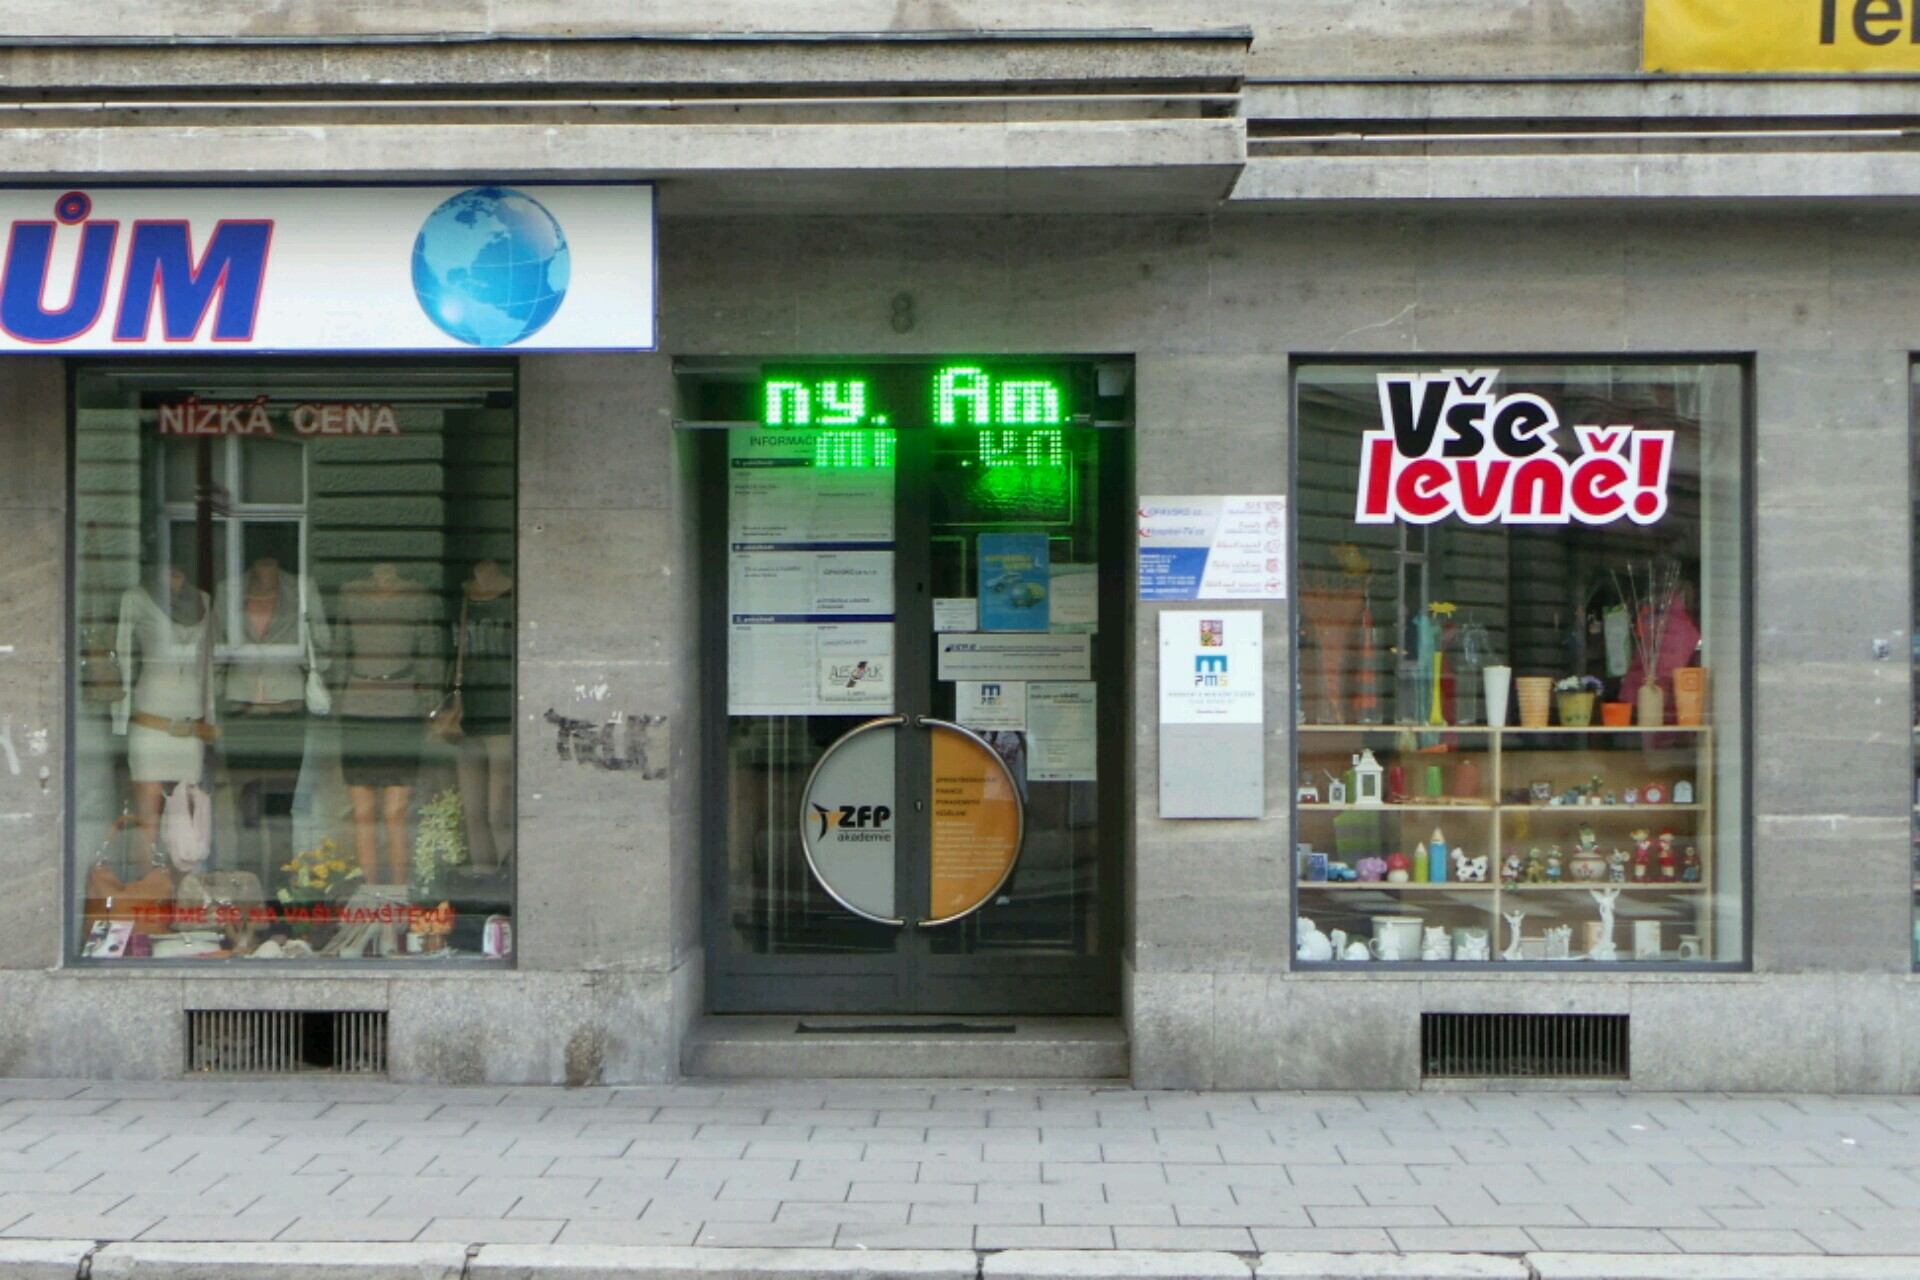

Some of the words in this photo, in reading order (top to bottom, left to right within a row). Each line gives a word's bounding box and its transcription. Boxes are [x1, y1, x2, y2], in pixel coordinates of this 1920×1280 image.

[892, 293, 914, 334] 8
[157, 395, 273, 435] NÍZKÁ
[291, 403, 399, 435] CENA
[1382, 374, 1554, 458] Vše
[1361, 428, 1667, 520] levně!
[1195, 675, 1228, 687] PMS
[838, 805, 892, 828] ZFP
[837, 831, 892, 843] akademie
